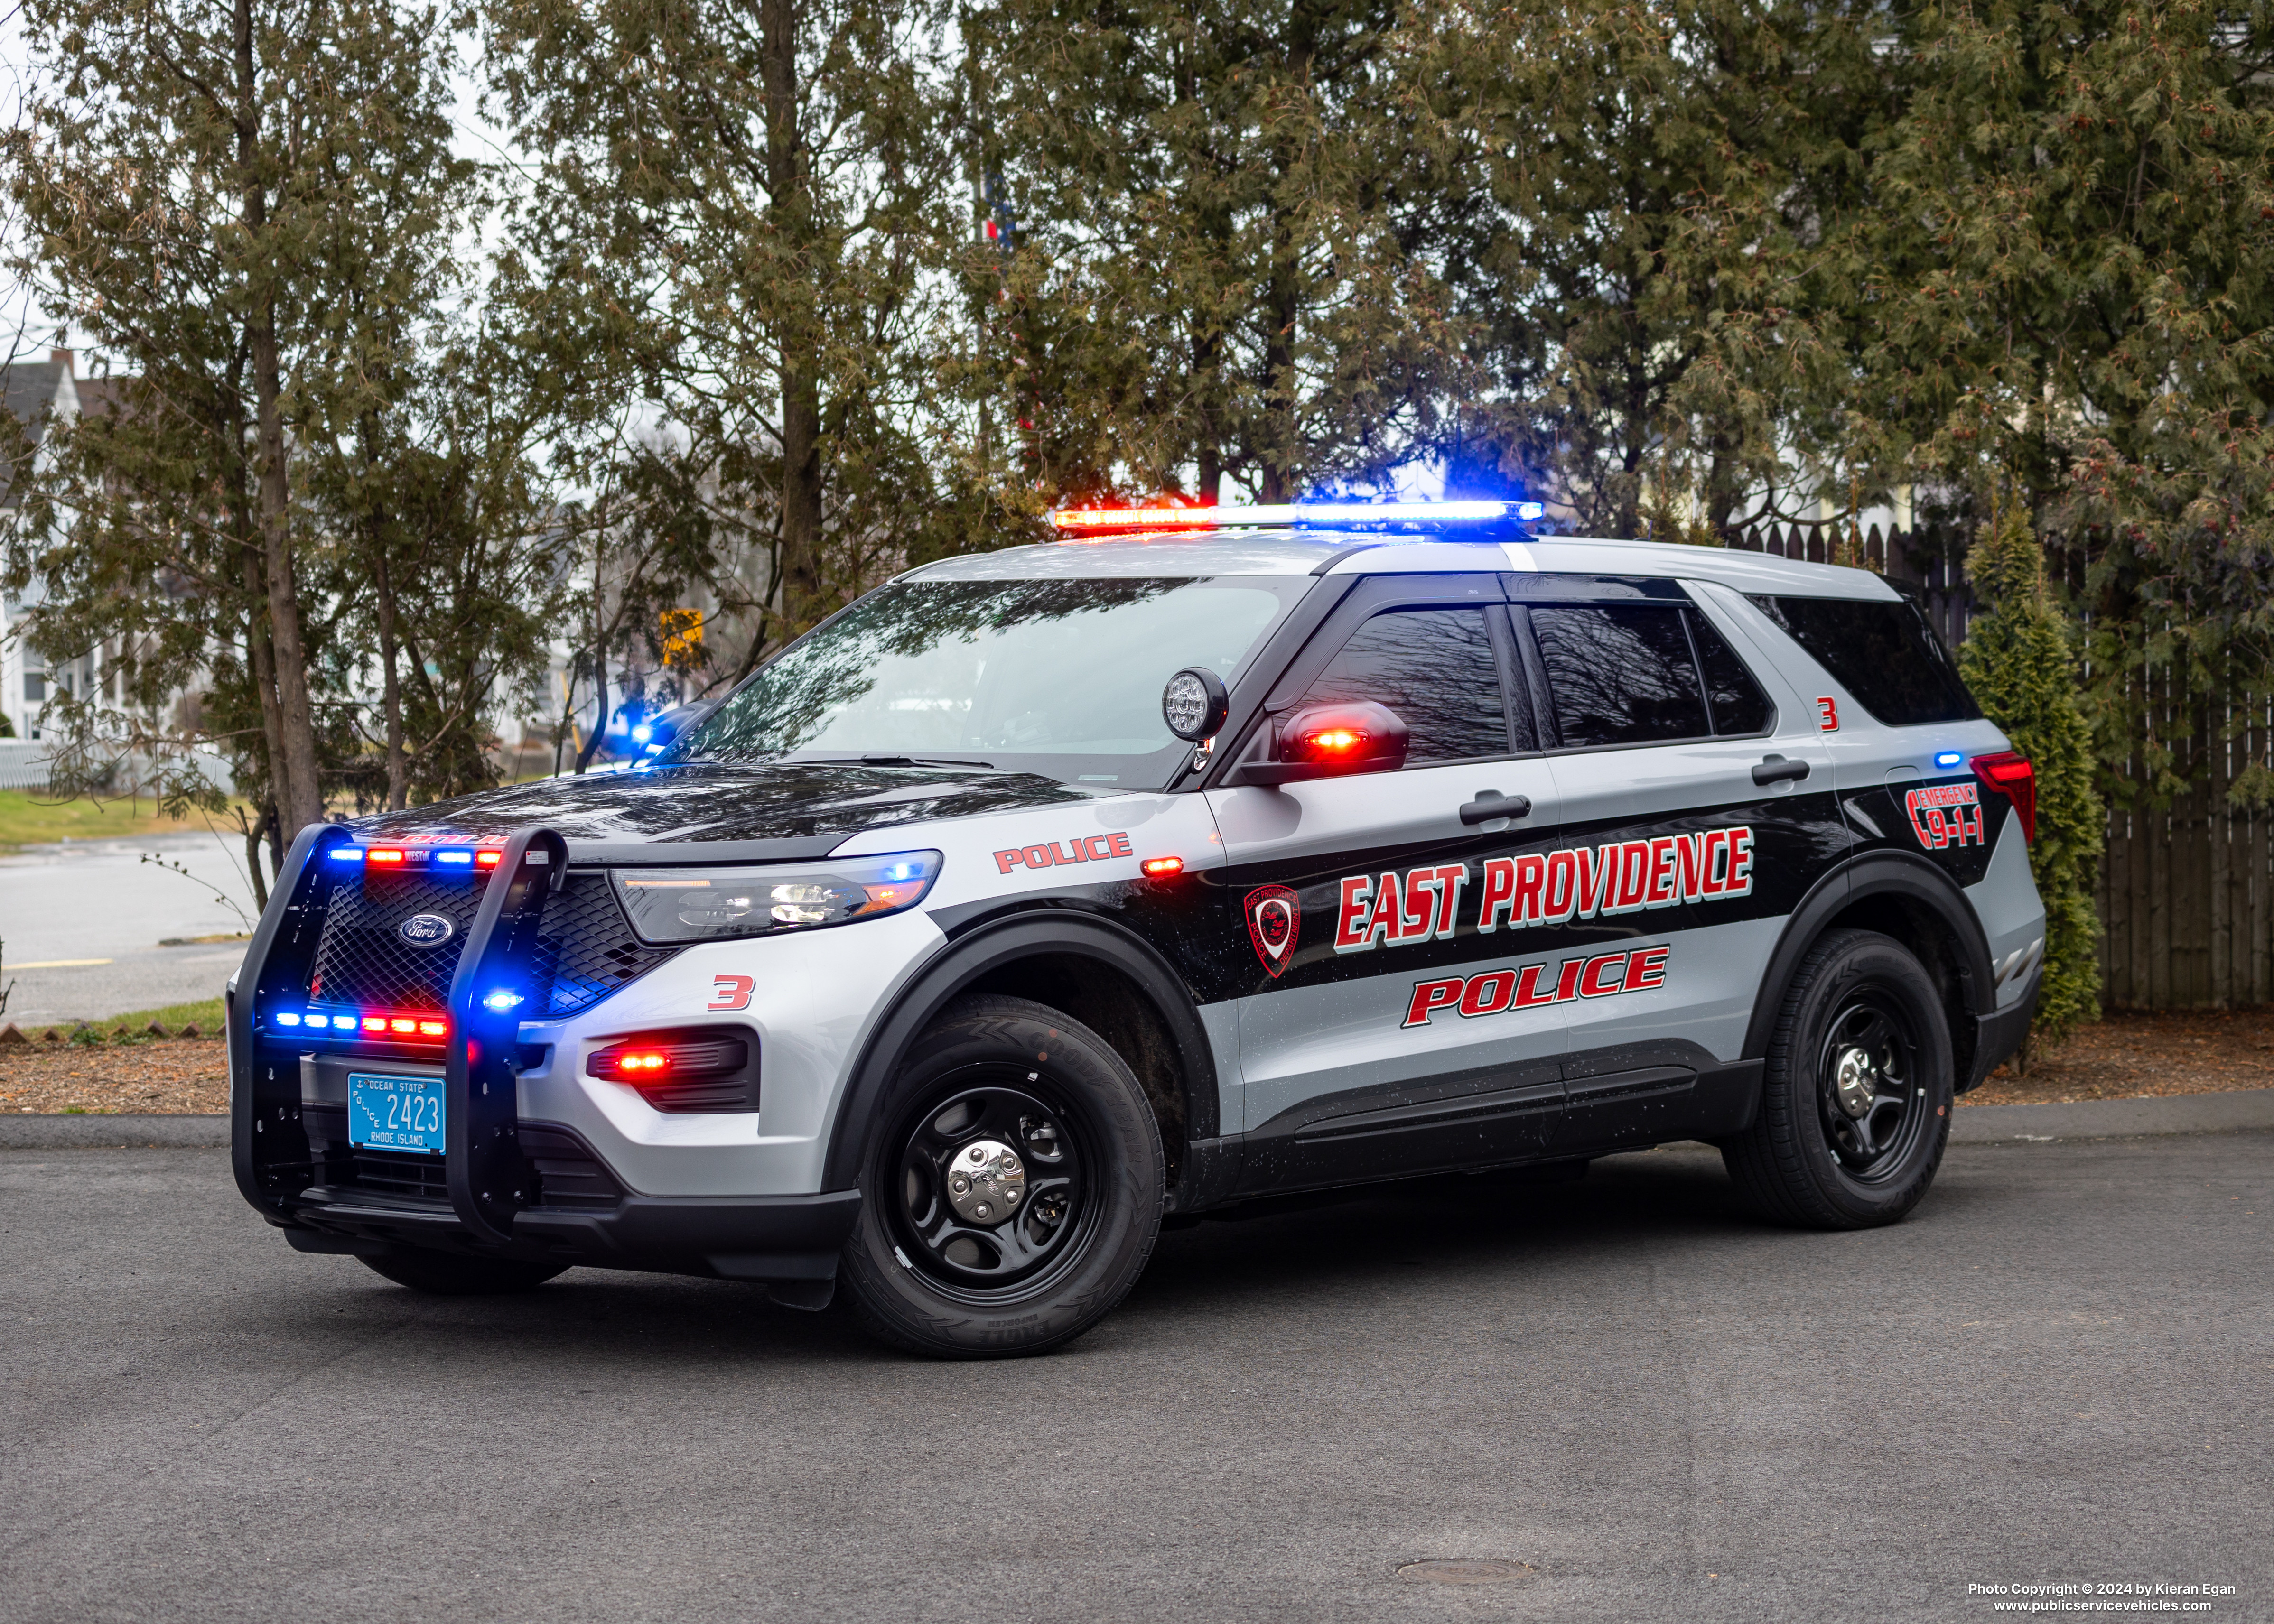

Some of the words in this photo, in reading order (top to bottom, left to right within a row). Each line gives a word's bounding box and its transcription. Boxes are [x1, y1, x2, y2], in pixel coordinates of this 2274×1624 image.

[1817, 696, 1839, 732] 3
[1918, 783, 1979, 809] EMERGENCY
[1926, 804, 1985, 849] 9-1-1
[992, 832, 1133, 874] POLICE
[1247, 893, 1260, 910] EAST
[1261, 888, 1297, 904] PROVIDENCE
[1333, 863, 1469, 954] EAST
[1477, 826, 1754, 934] PROVIDENCE
[409, 920, 438, 937] Ford
[1251, 922, 1268, 959] POLICE
[1279, 907, 1298, 965] DEPARTMENT
[707, 974, 756, 1012] 3
[1400, 944, 1670, 1029] POLICE
[369, 1080, 394, 1090] OCEAN
[399, 1083, 423, 1093] STATE
[353, 1091, 379, 1128] POLICE
[387, 1094, 438, 1132] 2423
[371, 1132, 394, 1143] RHODE
[398, 1133, 423, 1146] ISLAND
[975, 1319, 1050, 1345] EAGLE
[988, 1313, 1038, 1327] ENFORCER
